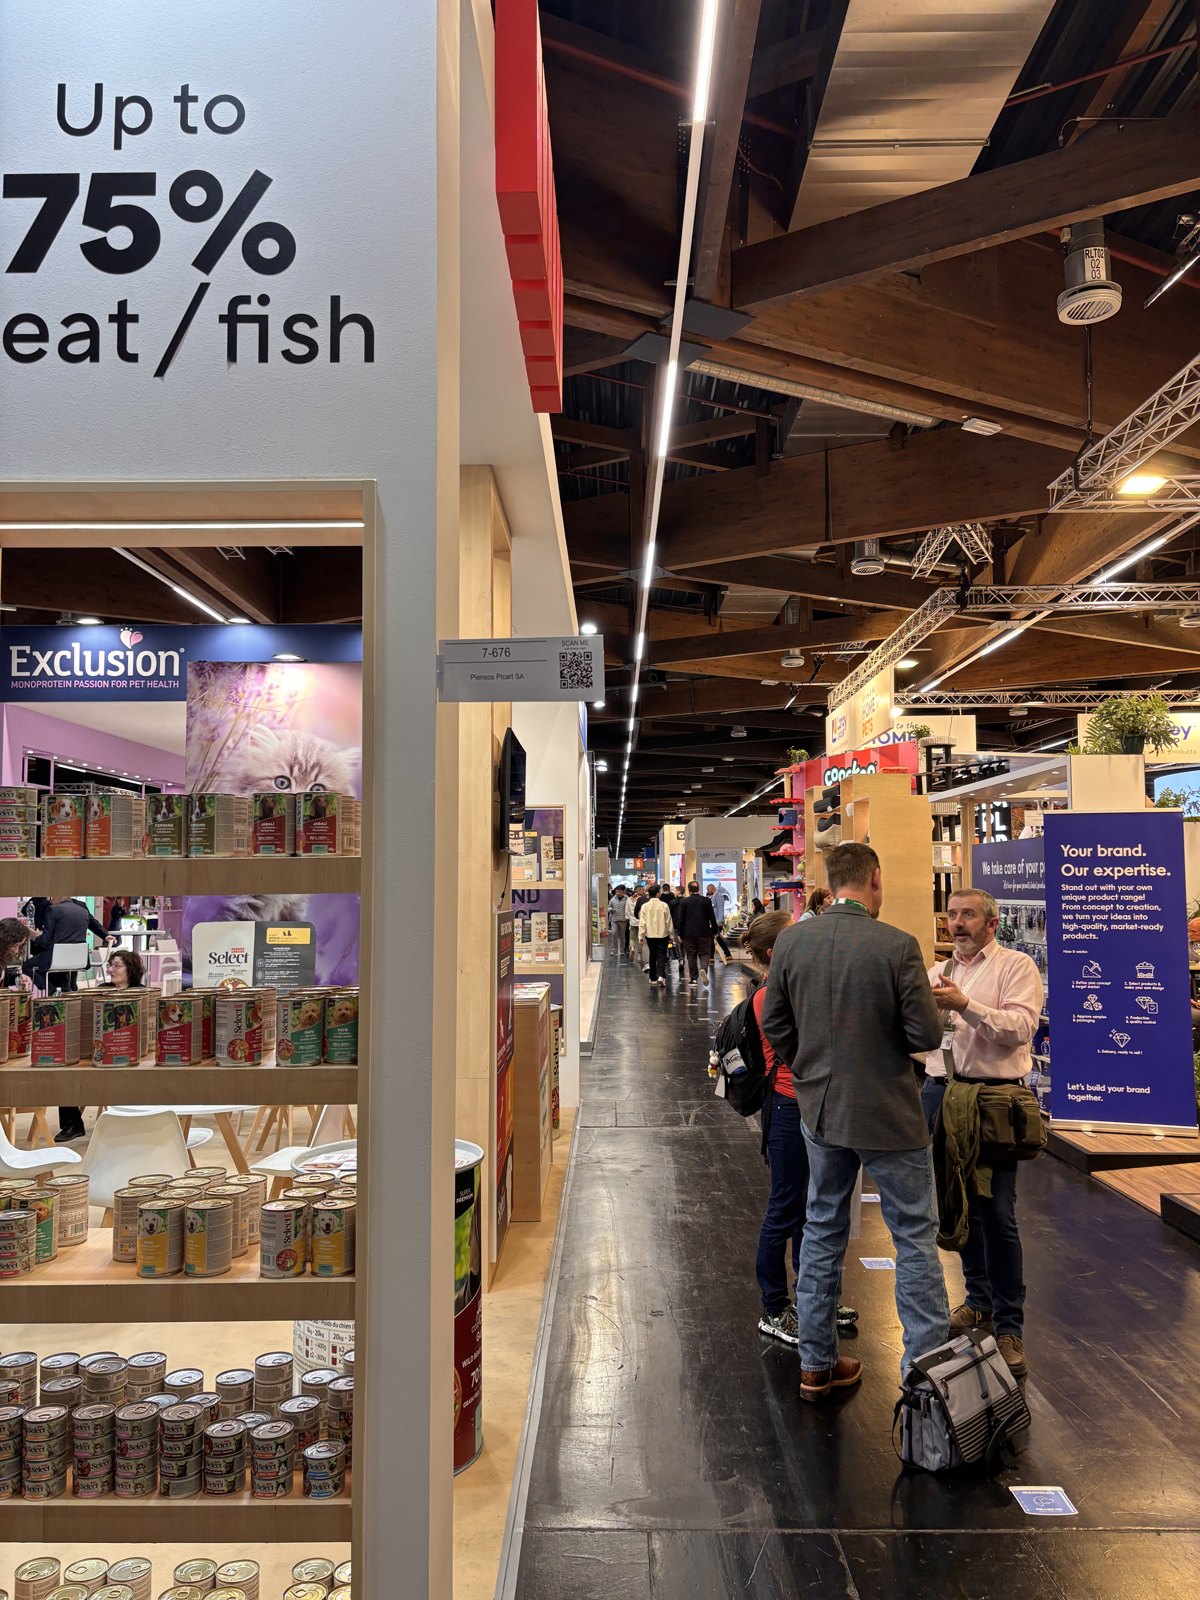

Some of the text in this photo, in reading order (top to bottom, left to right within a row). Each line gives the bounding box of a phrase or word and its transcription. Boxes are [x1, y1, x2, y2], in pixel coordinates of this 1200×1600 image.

[57, 83, 246, 150] Up to
[2, 169, 297, 276] 75%
[1085, 248, 1104, 259] RLT02
[1090, 259, 1100, 268] 02
[1091, 270, 1101, 280] 03
[218, 293, 375, 364] fish
[482, 647, 511, 658] 7-676
[11, 680, 179, 689] MONOPROTEIN PASSION FOR PET HEALTH
[1060, 844, 1146, 857] Your brand.
[982, 861, 990, 875] We
[992, 860, 1003, 875] take
[1004, 864, 1016, 875] care
[1018, 858, 1024, 874] of
[1026, 862, 1038, 878] your
[1061, 864, 1171, 880] Our expertise.
[1062, 894, 1145, 902] unique product range!
[1083, 904, 1113, 912] concept
[1062, 923, 1163, 932] high-quality, market-ready
[208, 951, 250, 965] Select
[234, 1009, 242, 1034] Select
[1068, 1083, 1150, 1094] Let's build your brand
[1068, 1093, 1103, 1102] together.
[284, 1218, 292, 1244] Select
[333, 1333, 344, 1342] 20kg
